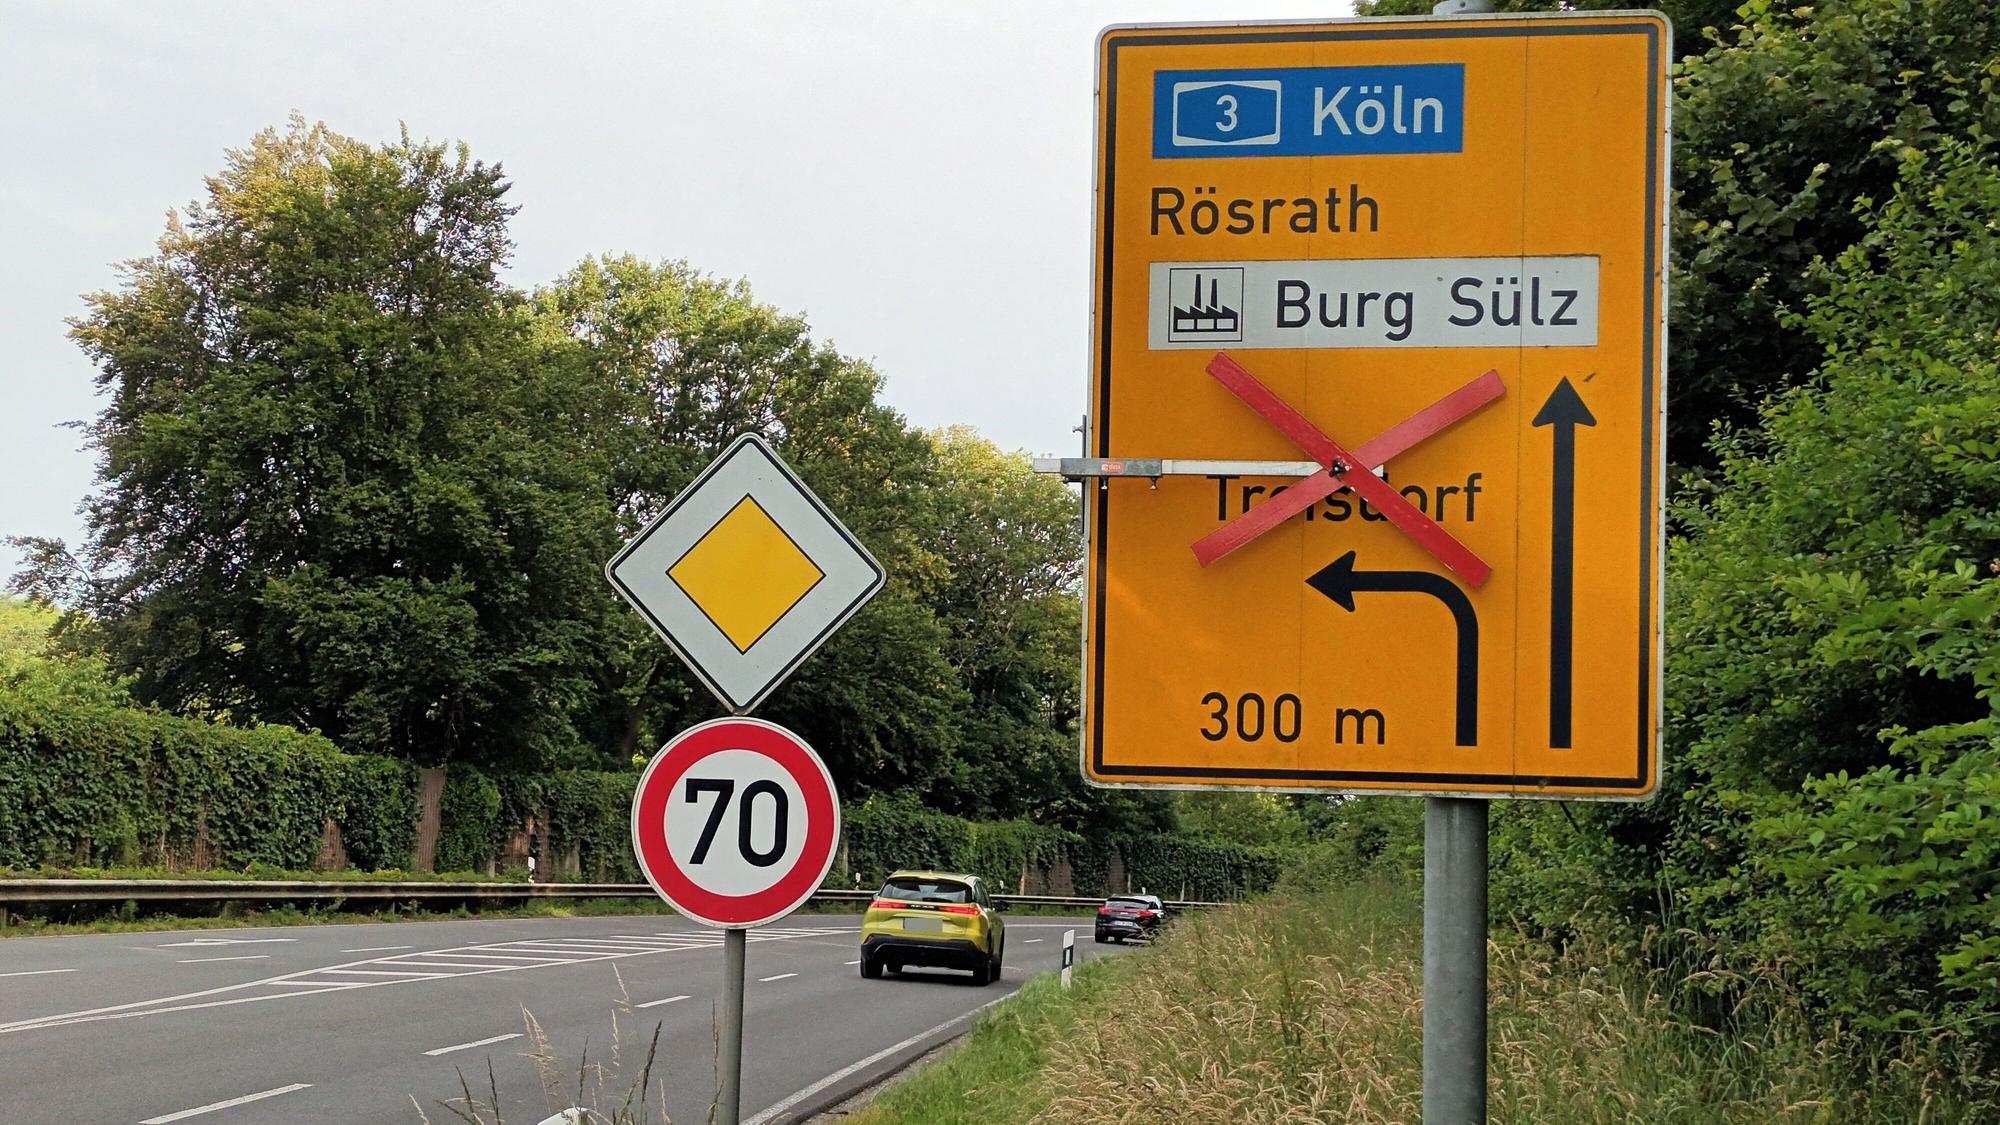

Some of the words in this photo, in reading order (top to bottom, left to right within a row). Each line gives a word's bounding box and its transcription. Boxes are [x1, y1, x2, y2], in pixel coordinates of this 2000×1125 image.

[1215, 94, 1238, 132] 3
[1313, 85, 1443, 136] Köln
[1150, 184, 1379, 236] Rösrath
[1276, 279, 1414, 342] Burg
[1447, 277, 1578, 327] Sülz
[1200, 691, 1302, 743] 300
[1335, 708, 1386, 745] m
[685, 778, 789, 868] 70
